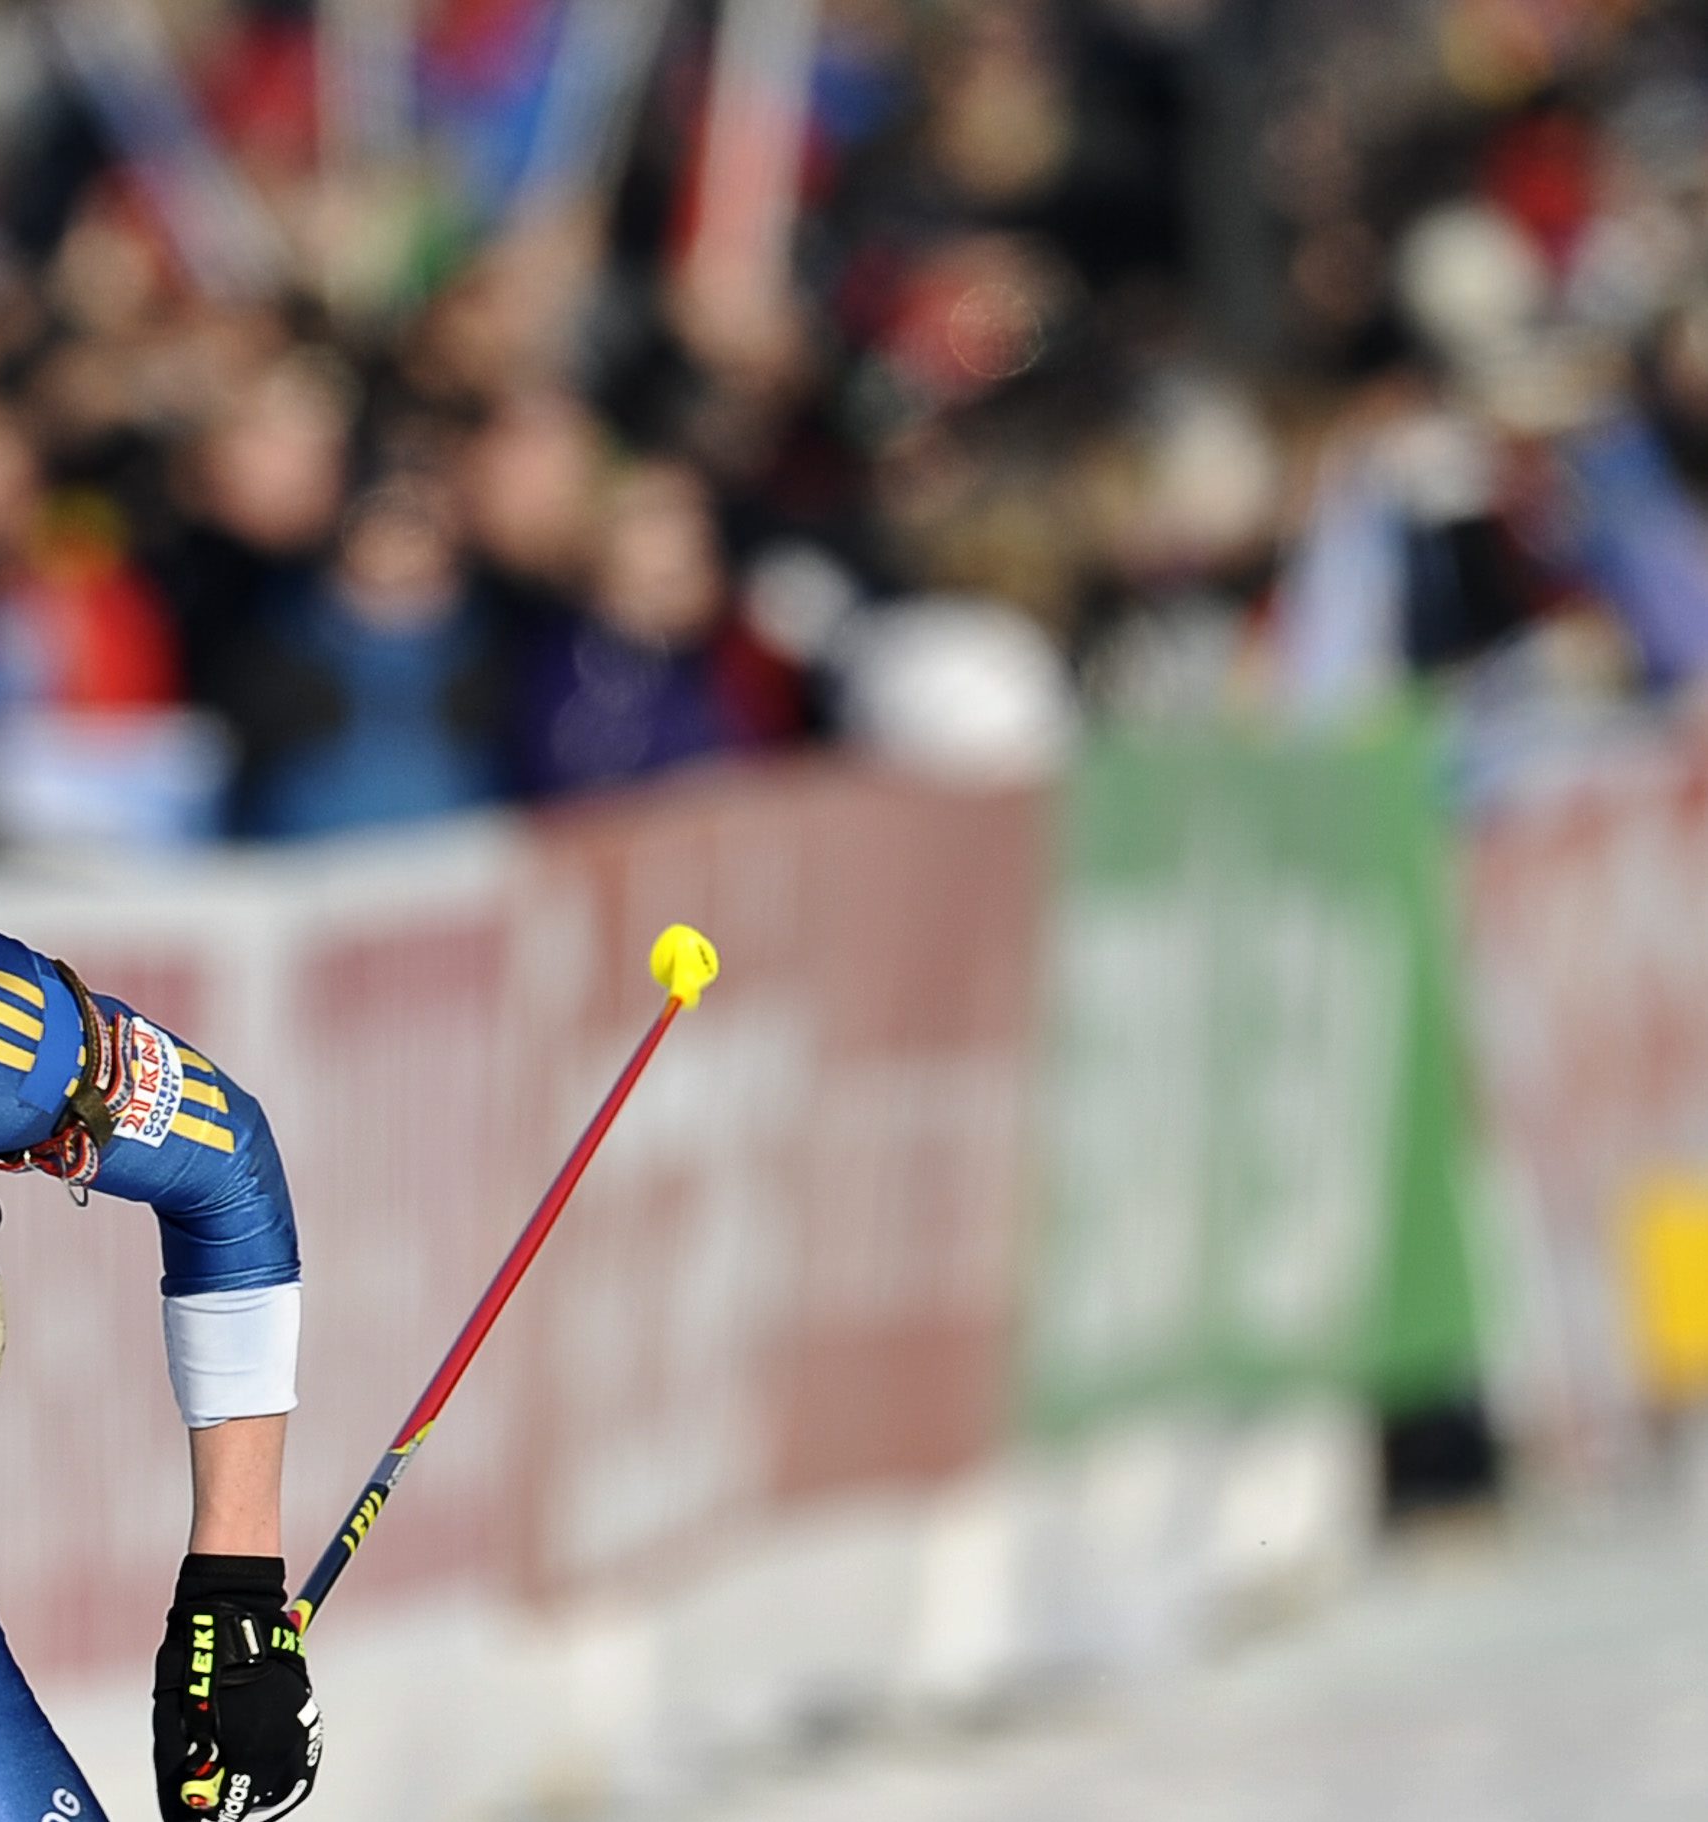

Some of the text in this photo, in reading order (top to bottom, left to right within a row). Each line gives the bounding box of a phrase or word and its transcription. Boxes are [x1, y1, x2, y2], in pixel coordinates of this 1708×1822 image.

[120, 1099, 151, 1133] 21
[150, 1072, 182, 1139] VARVET
[188, 1614, 214, 1698] LEKI
